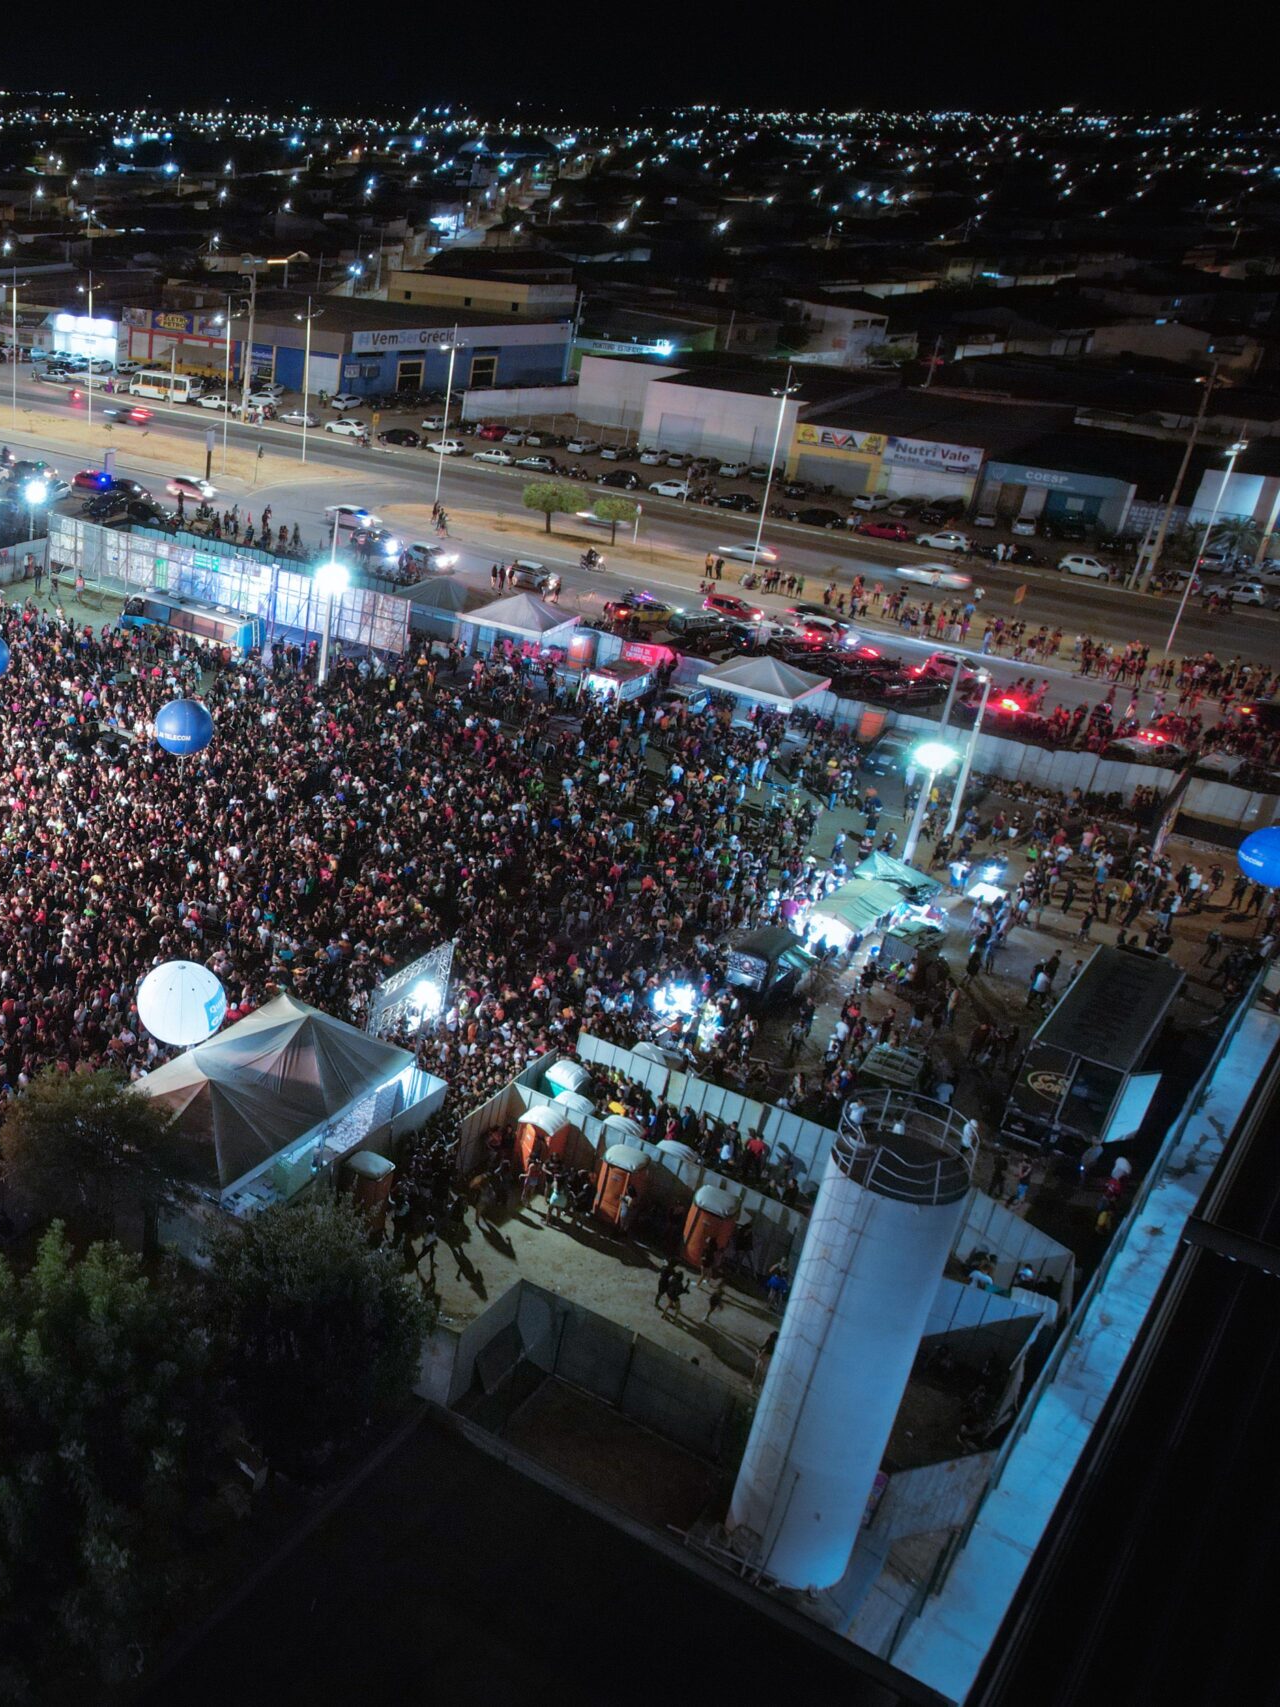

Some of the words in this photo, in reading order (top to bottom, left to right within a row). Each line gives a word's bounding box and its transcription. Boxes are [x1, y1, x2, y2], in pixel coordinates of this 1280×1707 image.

[821, 430, 858, 448] EVA
[895, 443, 937, 457] Nutri
[941, 447, 970, 462] Vale
[1025, 471, 1069, 484] COESP
